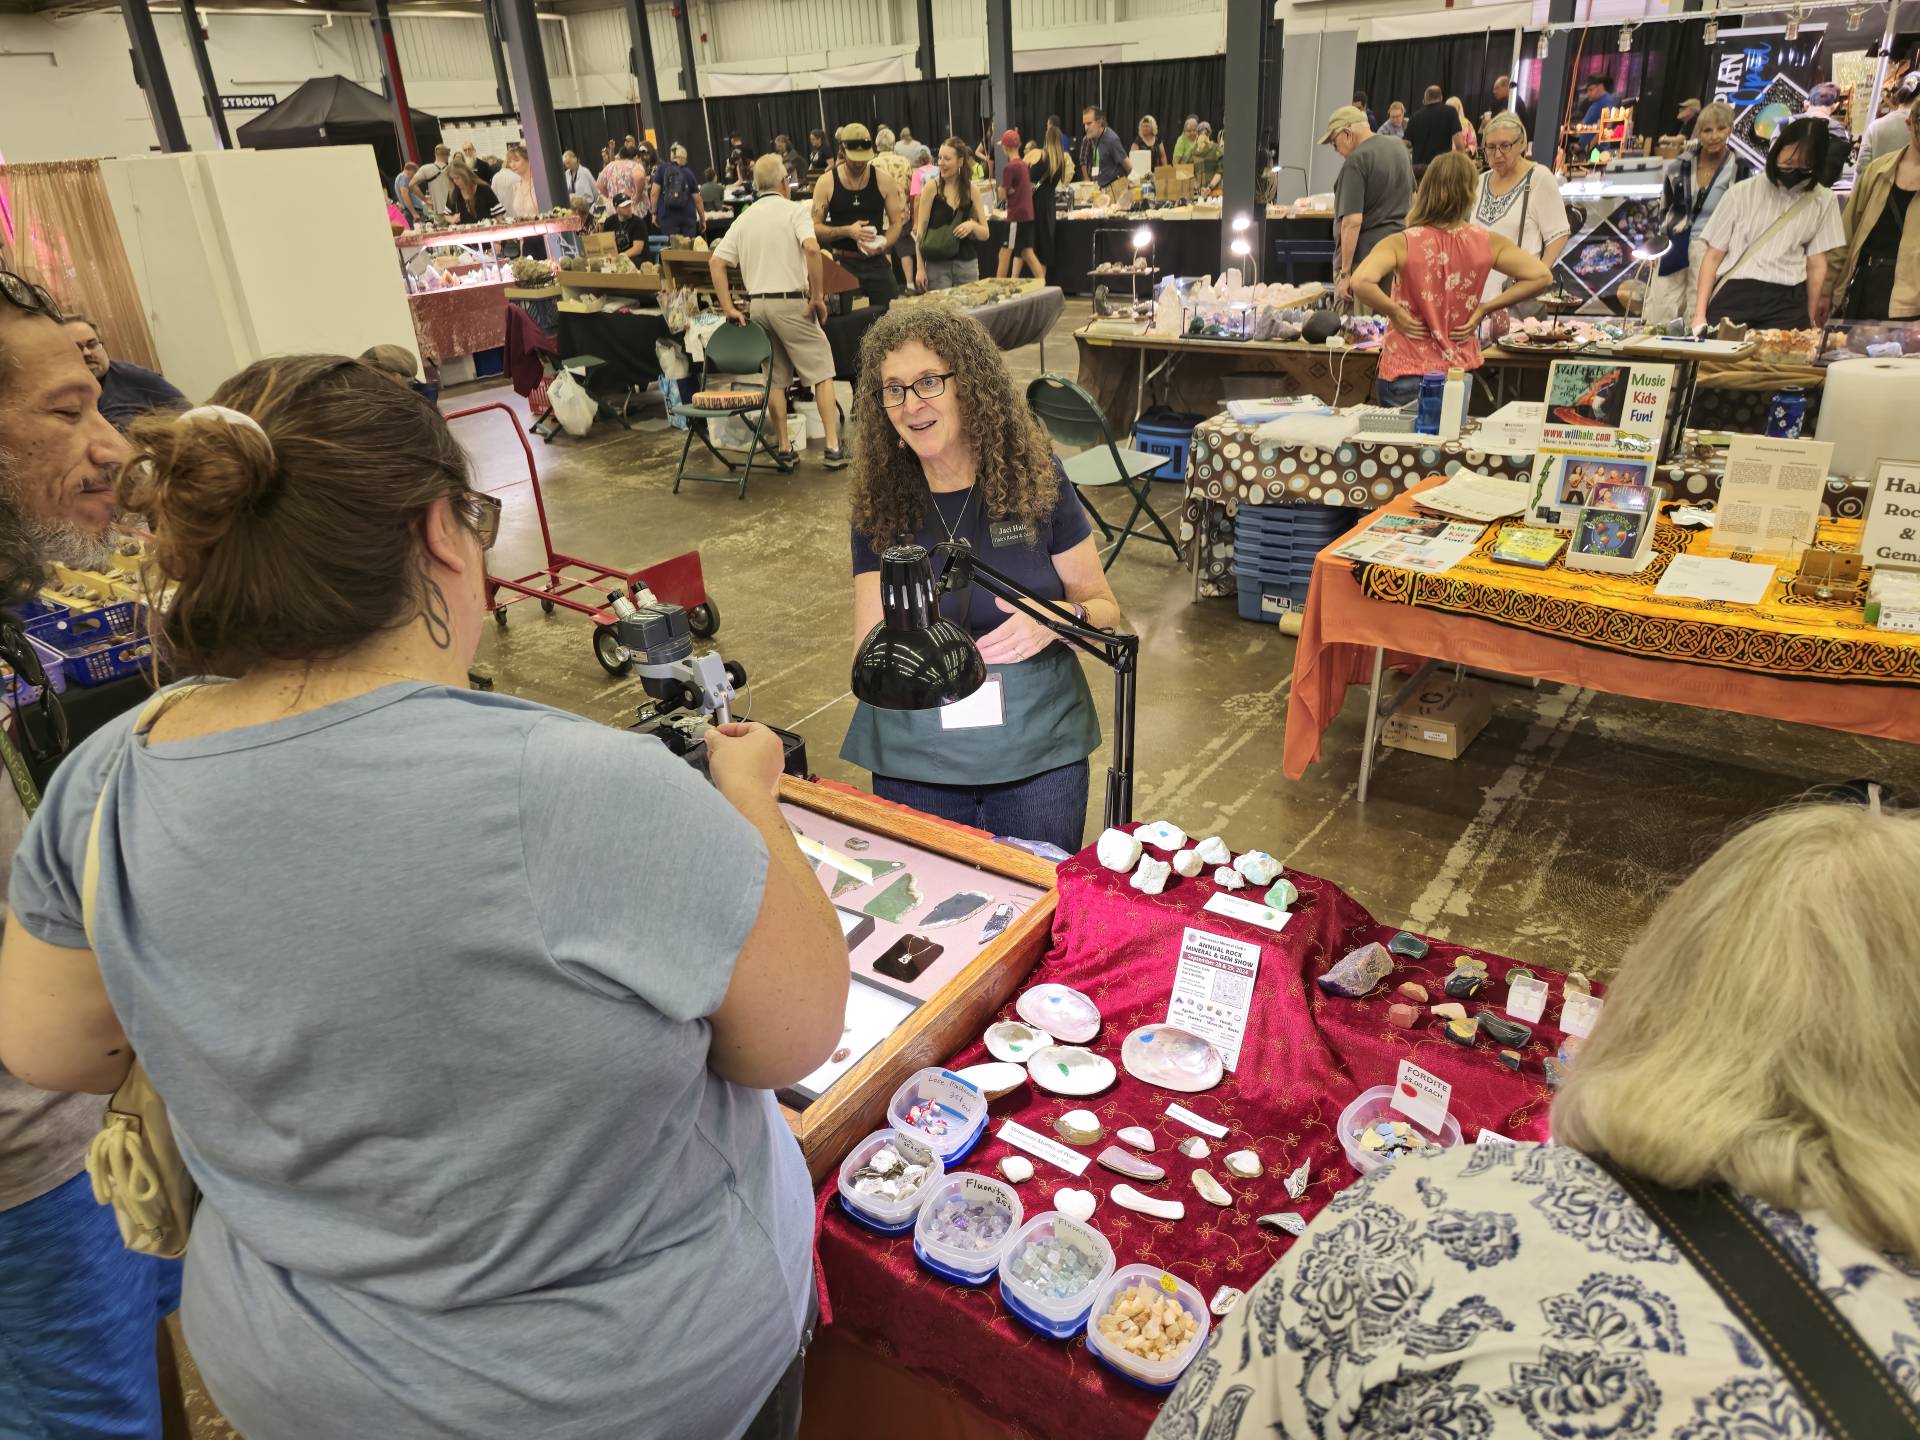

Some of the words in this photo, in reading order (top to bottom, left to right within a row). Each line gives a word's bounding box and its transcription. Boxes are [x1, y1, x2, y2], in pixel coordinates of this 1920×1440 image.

[222, 96, 275, 108] STROOMS
[1631, 373, 1666, 387] Music
[1632, 391, 1657, 405] Kids
[1630, 409, 1654, 423] Fun!
[1543, 428, 1612, 442] www.willhale.com
[1884, 477, 1920, 494] Ha
[1884, 503, 1920, 518] Roc
[1899, 527, 1916, 541] &
[1876, 546, 1920, 562] Gem
[1185, 944, 1212, 957] MINERAL
[1219, 953, 1233, 963] GEM
[1234, 956, 1254, 968] SHOW
[1198, 941, 1224, 954] ANNUAL
[1225, 948, 1243, 958] ROCK
[1187, 953, 1214, 967] September
[1407, 1066, 1448, 1092] FORDITE
[1423, 1086, 1443, 1100] EACH
